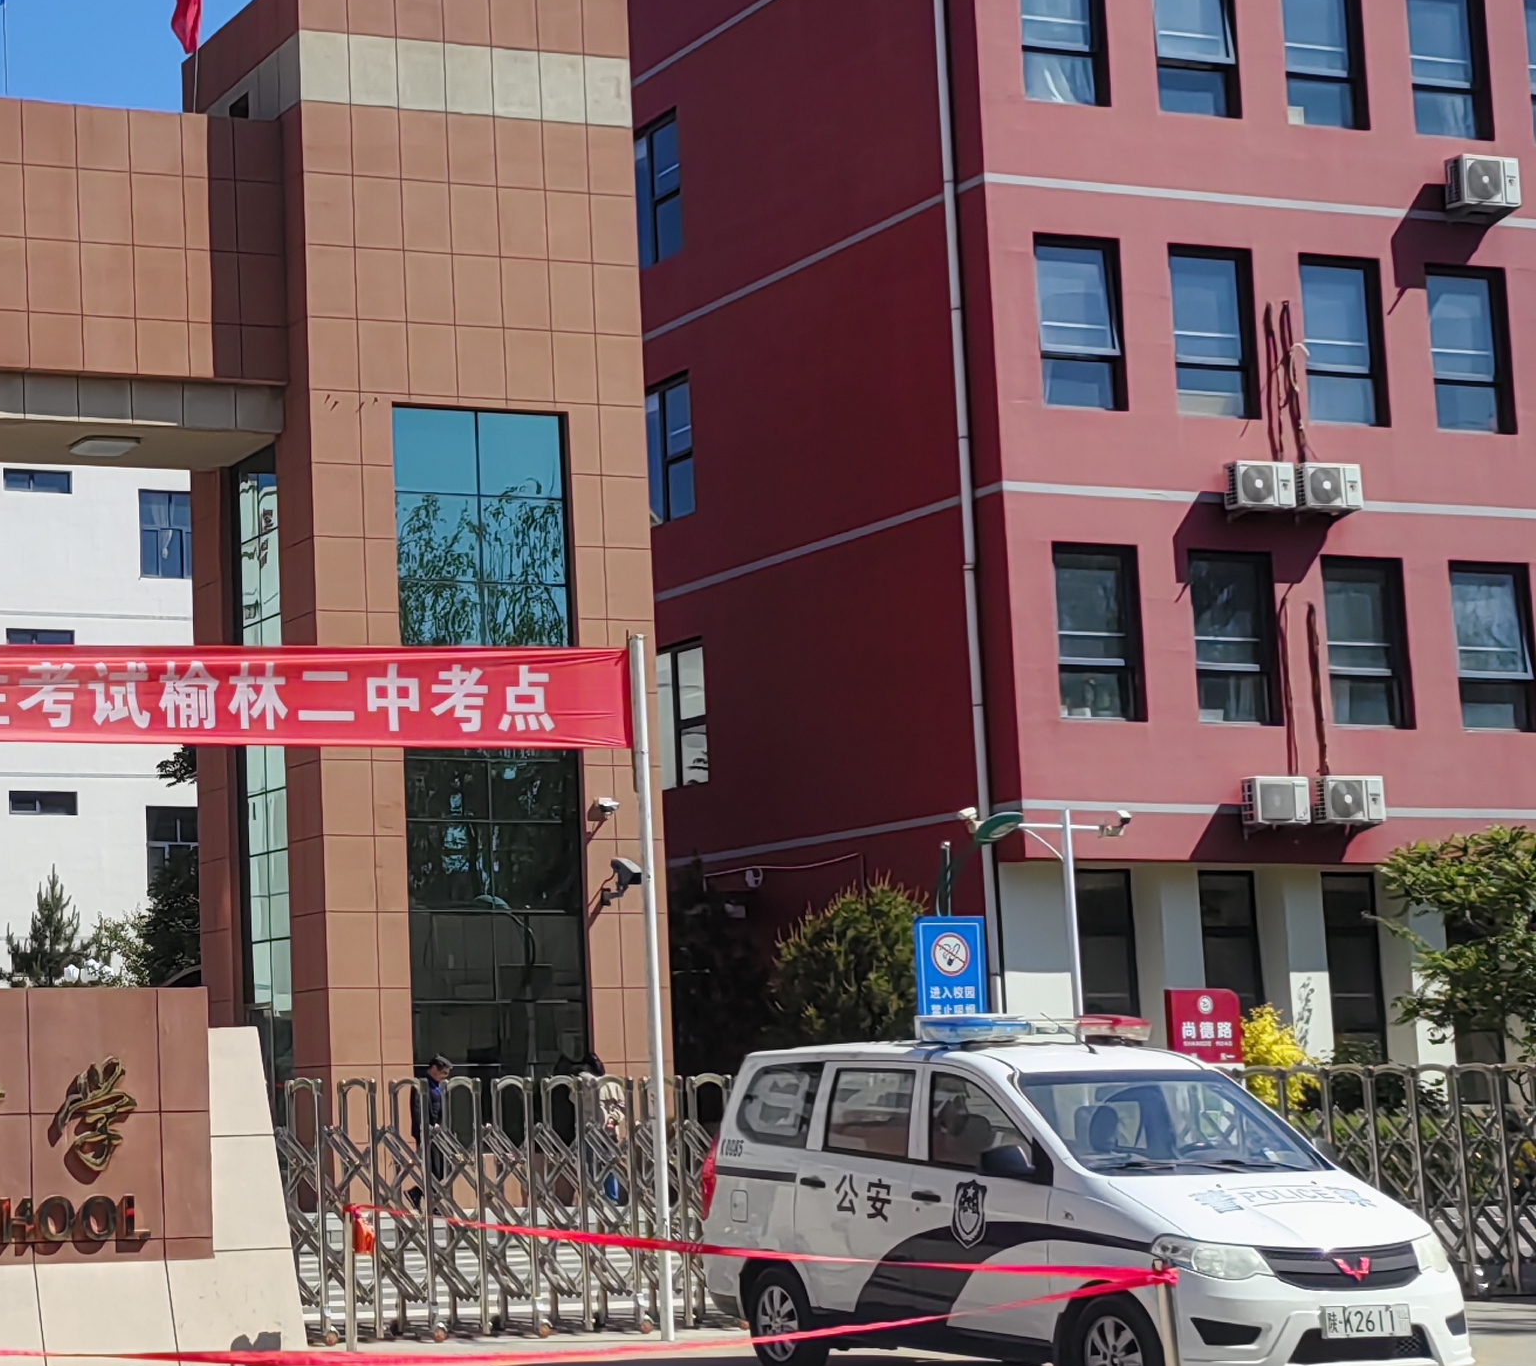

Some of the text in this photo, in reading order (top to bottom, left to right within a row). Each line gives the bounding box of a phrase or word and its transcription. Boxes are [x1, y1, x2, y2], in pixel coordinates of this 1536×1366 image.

[930, 986, 976, 999] 进入校园
[1182, 1021, 1233, 1039] 尚德路
[834, 1173, 892, 1223] 公安
[1239, 1188, 1336, 1203] POLICE
